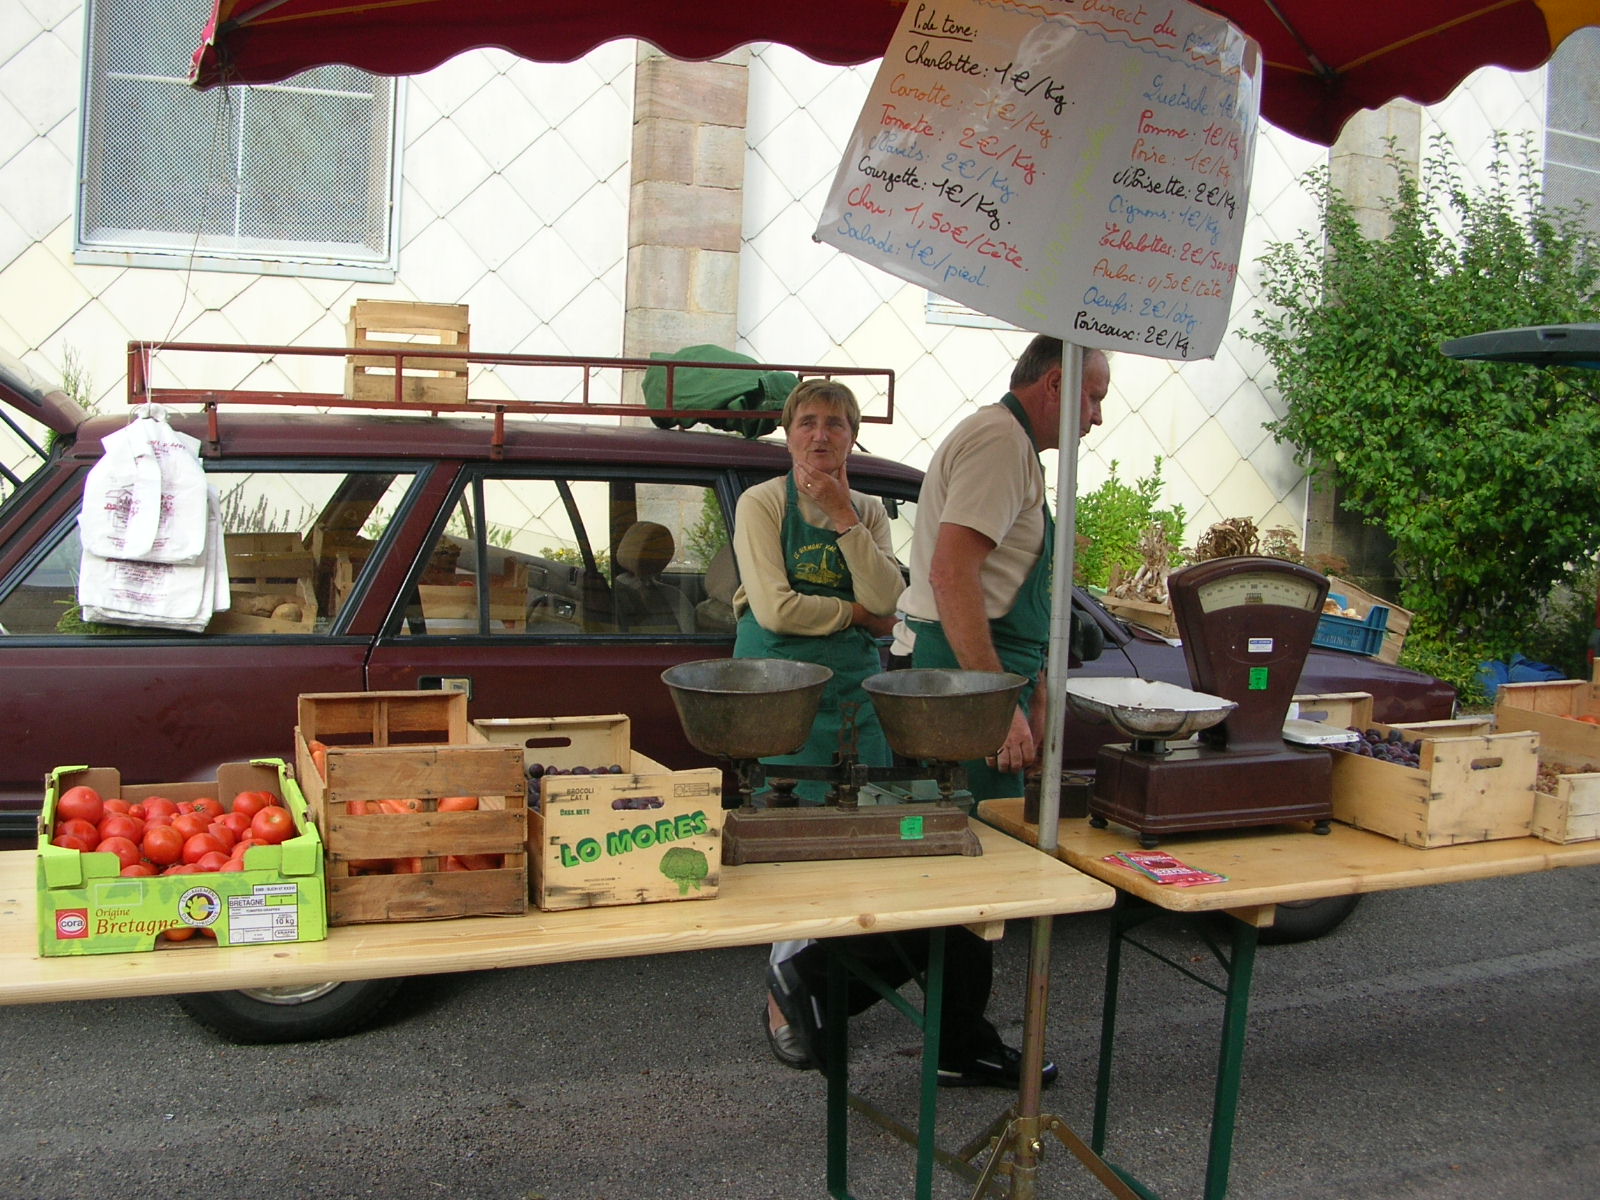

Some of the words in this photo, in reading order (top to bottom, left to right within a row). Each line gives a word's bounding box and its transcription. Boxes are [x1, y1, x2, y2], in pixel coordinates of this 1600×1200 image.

[1153, 10, 1177, 37] du
[566, 787, 595, 796] BROCOLI
[560, 837, 602, 868] LO
[606, 810, 708, 857] MORES
[229, 898, 265, 907] BRETAGNE
[95, 908, 131, 921] Origine
[60, 919, 84, 929] cora
[95, 918, 179, 937] Bretagne
